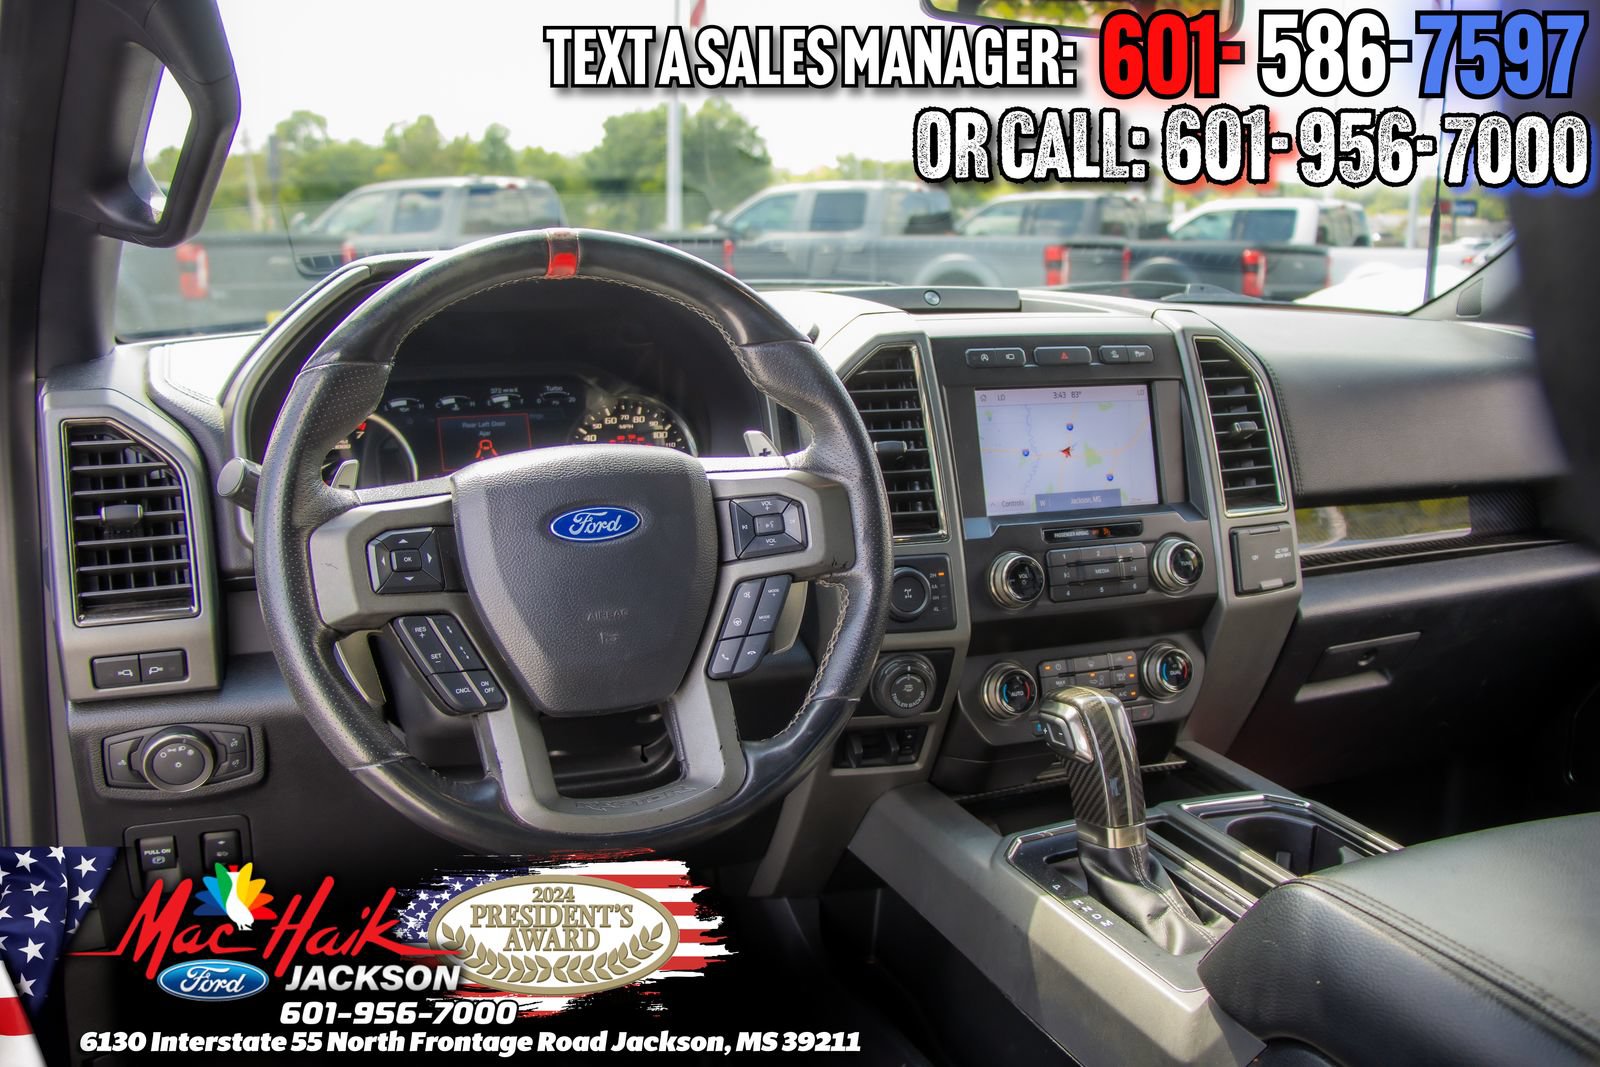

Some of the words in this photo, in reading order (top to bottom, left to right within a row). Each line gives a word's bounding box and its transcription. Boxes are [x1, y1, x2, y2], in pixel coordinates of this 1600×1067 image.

[1053, 391, 1066, 399] 3:43
[604, 417, 618, 425] 60
[632, 415, 646, 423] 80
[356, 431, 365, 439] 7
[583, 434, 597, 442] 40
[652, 431, 668, 439] 100
[1001, 499, 1025, 508] Controls
[569, 511, 622, 535] Ford
